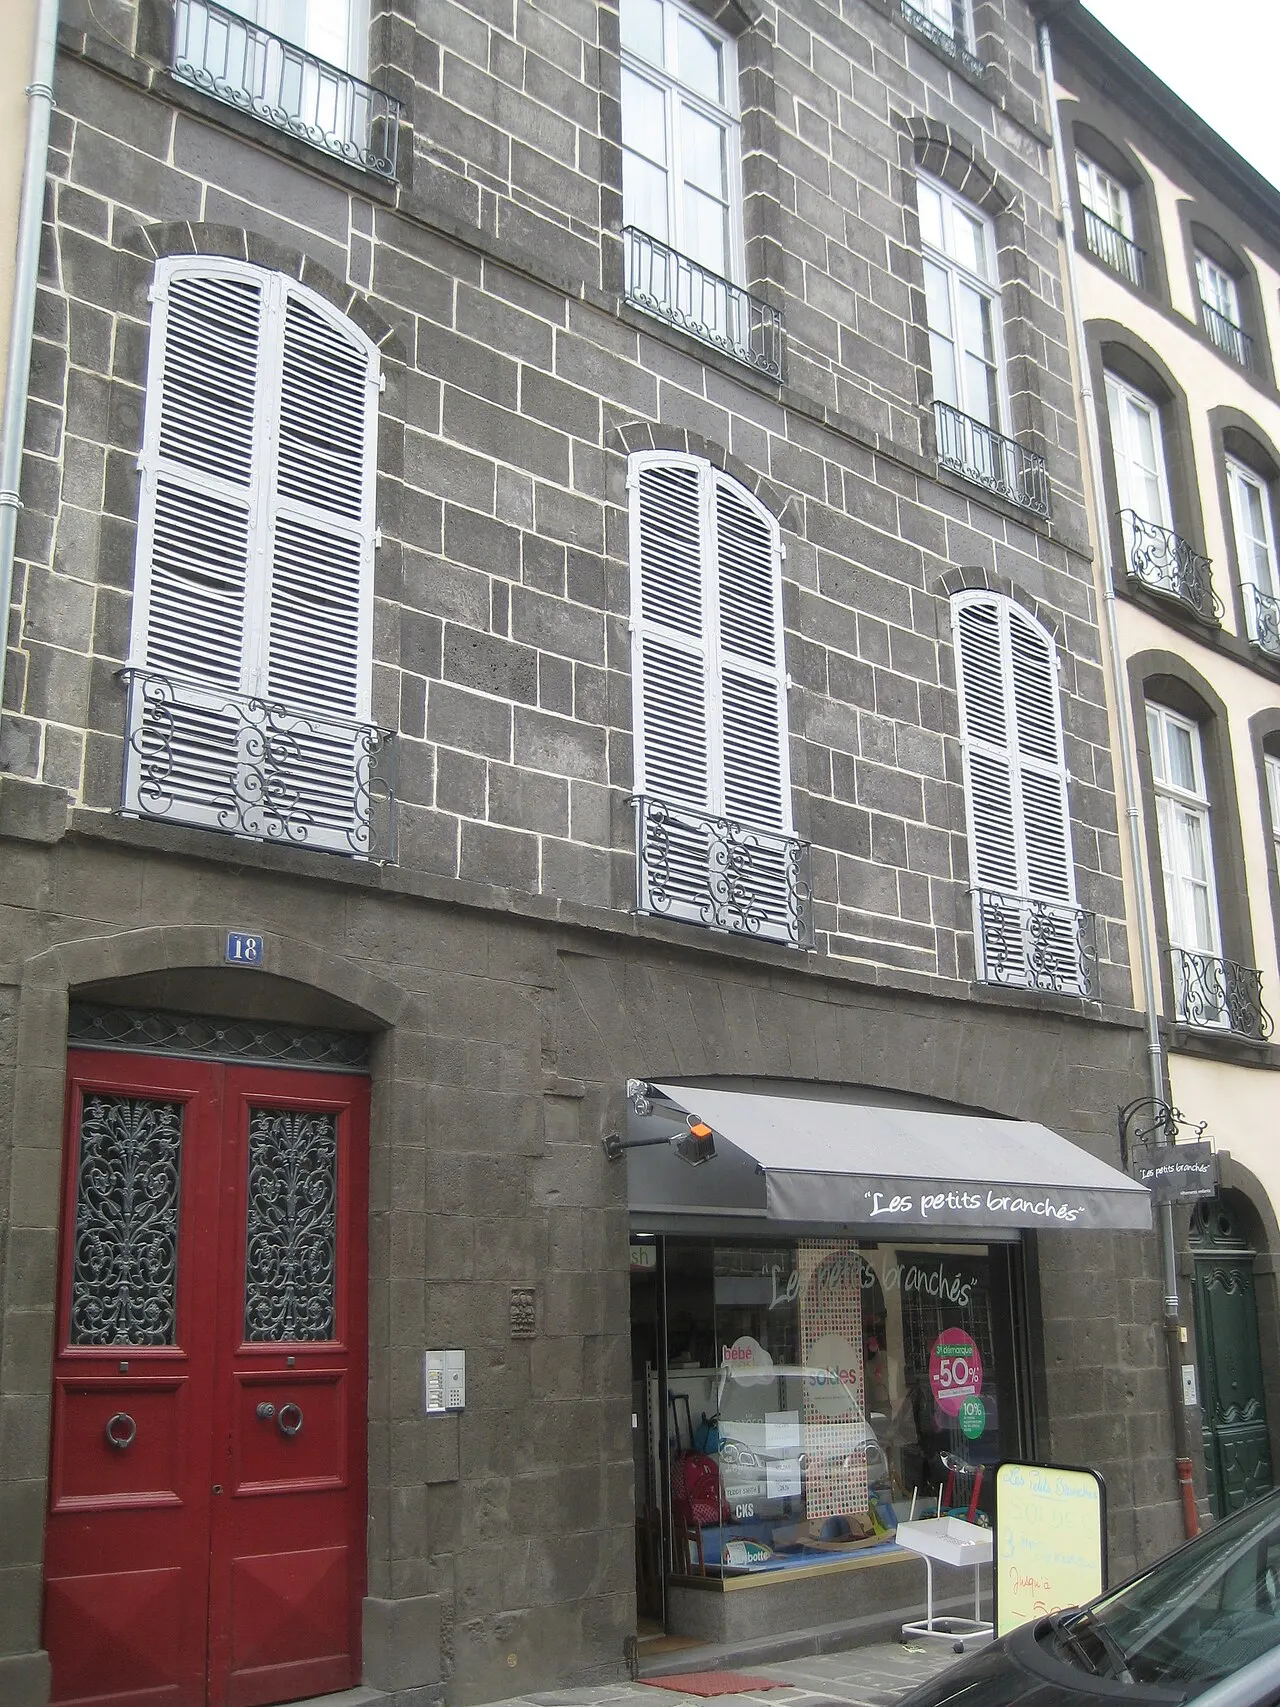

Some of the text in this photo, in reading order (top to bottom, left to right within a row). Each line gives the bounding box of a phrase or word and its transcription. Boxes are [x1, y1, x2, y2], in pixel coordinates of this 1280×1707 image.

[234, 936, 257, 960] 18
[1155, 1164, 1175, 1178] petits
[921, 1191, 981, 1217] petits
[724, 1345, 752, 1360] bébé
[808, 1365, 857, 1386] soldes
[963, 1403, 982, 1416] 10%
[735, 1503, 754, 1519] CKS
